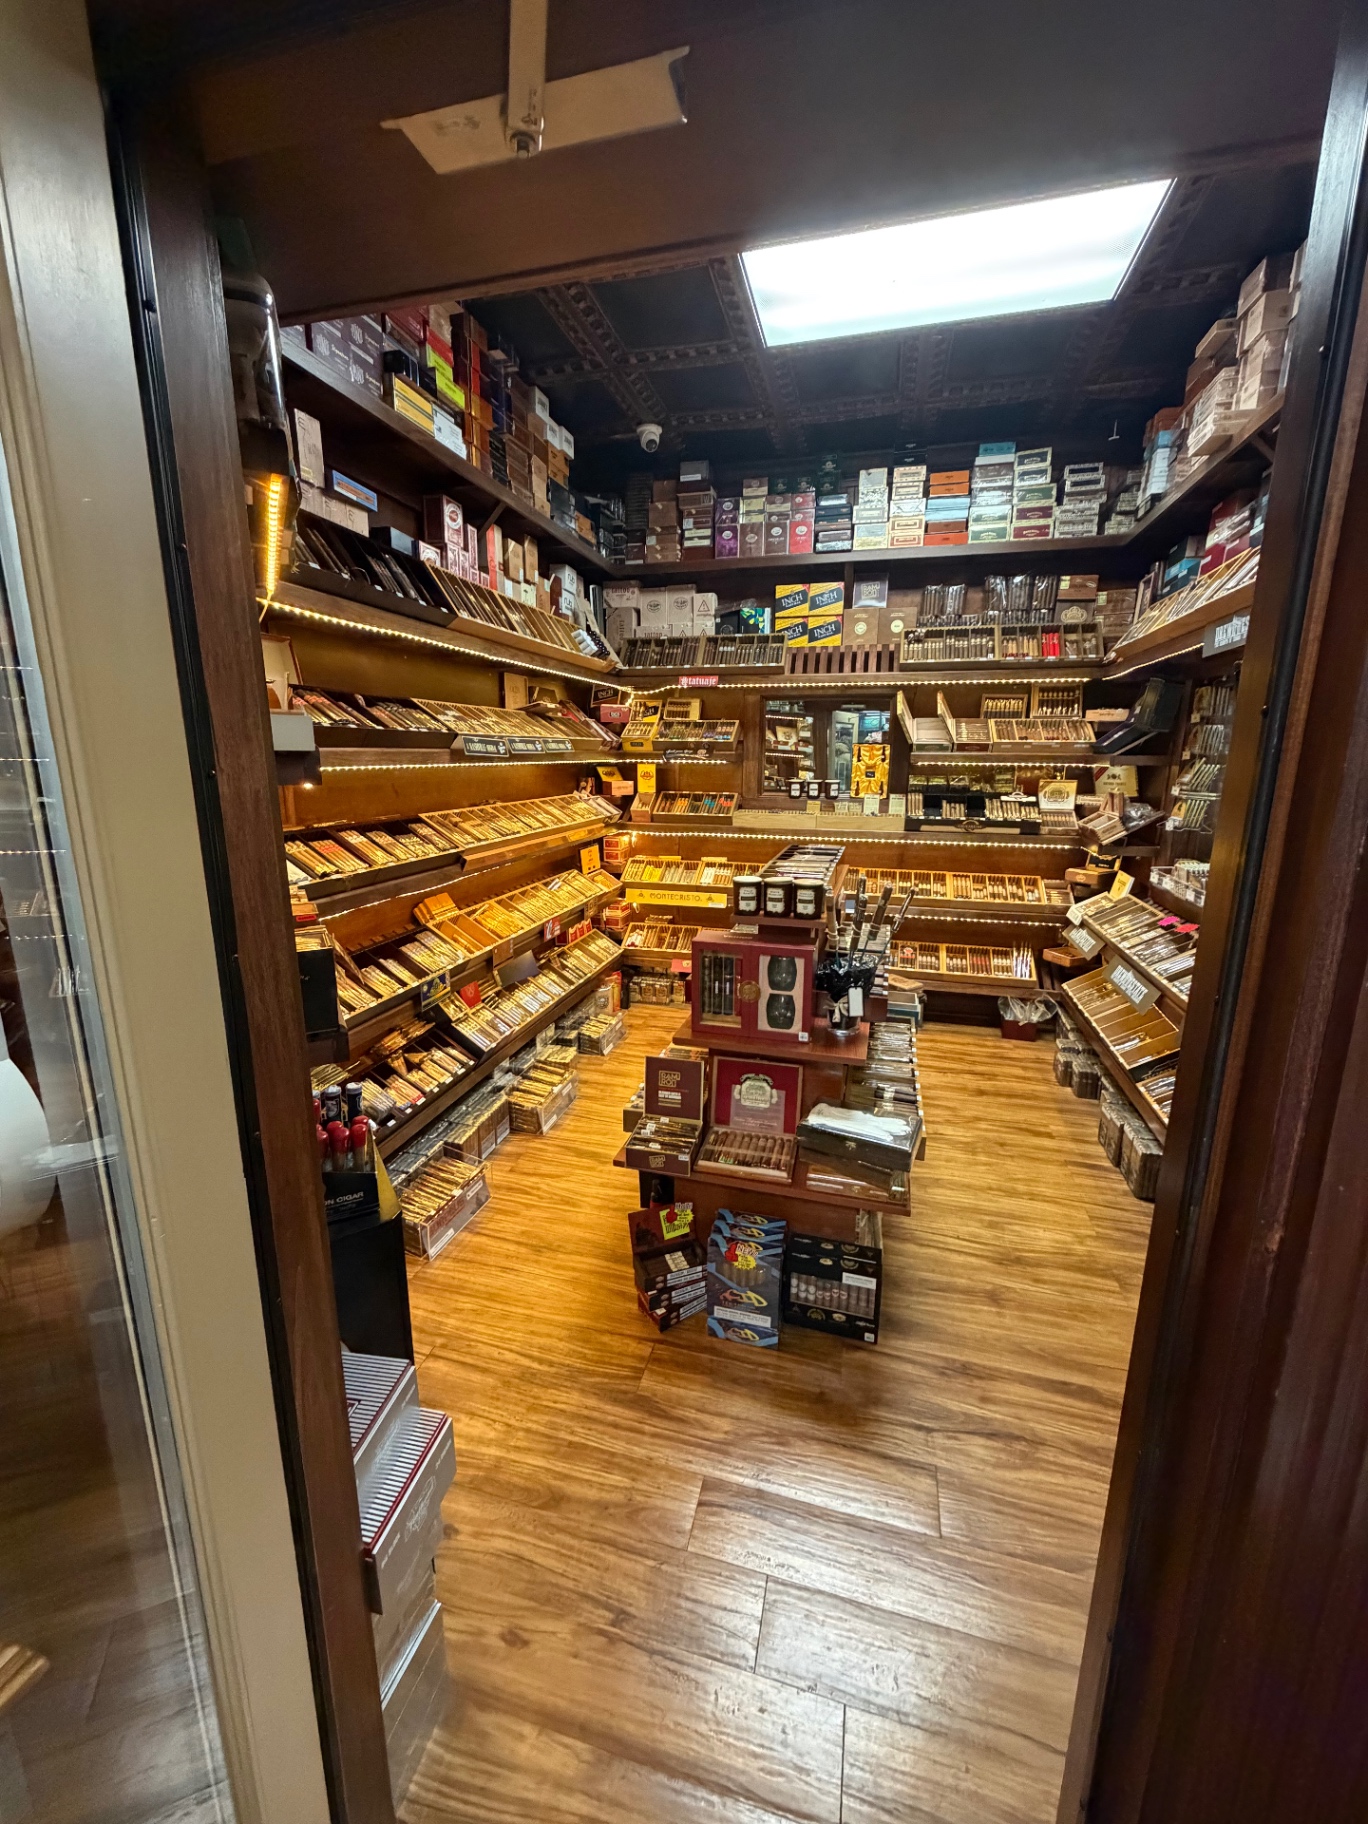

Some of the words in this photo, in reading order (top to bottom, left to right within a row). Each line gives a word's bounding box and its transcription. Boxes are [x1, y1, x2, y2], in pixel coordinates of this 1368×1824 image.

[781, 593, 803, 607] INCH
[815, 590, 838, 605] INCH
[814, 623, 836, 637] INCH
[336, 1191, 364, 1203] CIGAR
